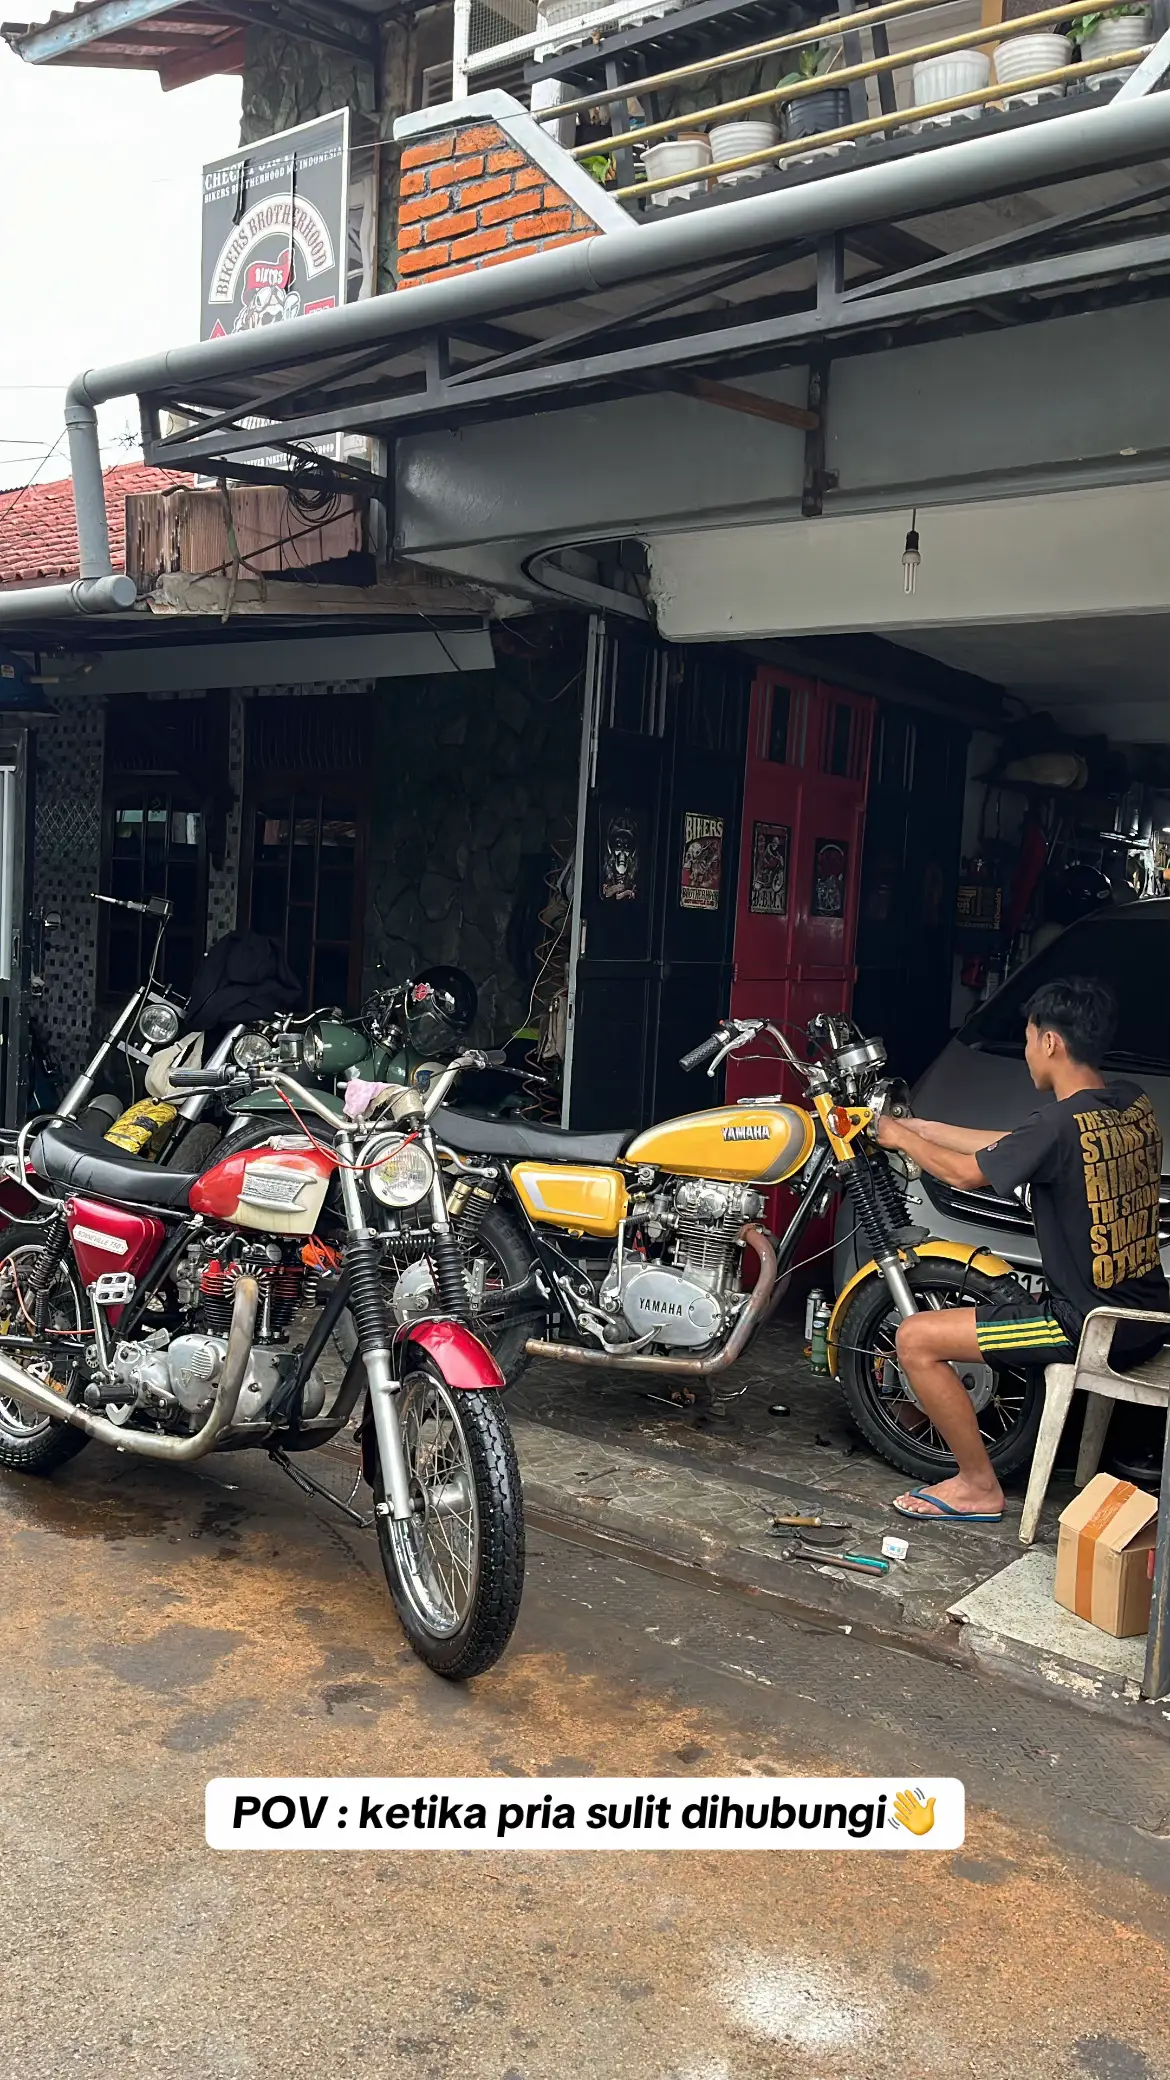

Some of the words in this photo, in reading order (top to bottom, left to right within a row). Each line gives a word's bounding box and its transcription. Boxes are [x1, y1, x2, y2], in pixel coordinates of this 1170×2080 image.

[204, 184, 230, 203] BIKERS
[216, 229, 249, 296] BIKERS
[248, 204, 327, 268] BROTHERHOOD
[685, 816, 724, 843] BIKERS
[722, 1126, 771, 1141] YAMAHA
[1072, 1110, 1105, 1133] THE
[1079, 1123, 1144, 1164] STAND
[1088, 1198, 1119, 1225] THE
[1121, 1182, 1160, 1218] STRON
[1089, 1209, 1148, 1255] STAND
[639, 1297, 682, 1317] YAMAHA
